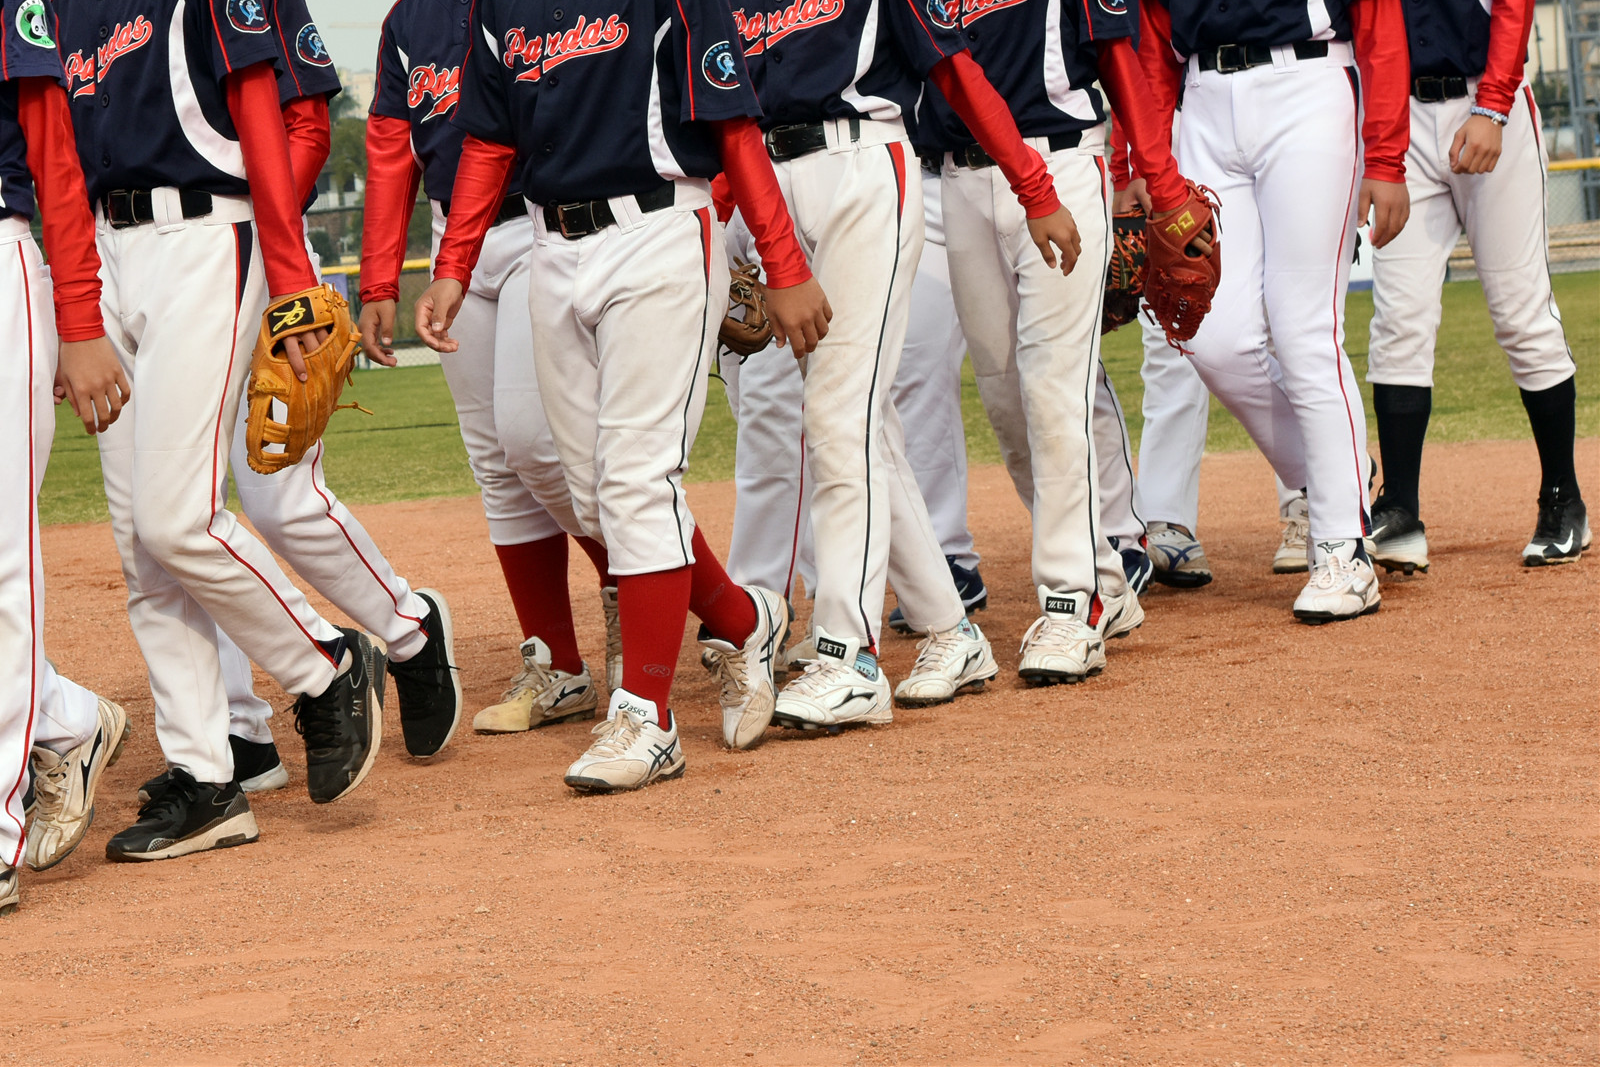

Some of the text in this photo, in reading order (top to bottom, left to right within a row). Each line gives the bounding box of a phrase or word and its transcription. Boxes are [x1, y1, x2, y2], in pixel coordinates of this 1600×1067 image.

[64, 14, 153, 99] Pandas
[503, 13, 630, 83] Pandas
[1047, 599, 1075, 611] ZETT
[818, 640, 846, 658] ZETT
[626, 704, 649, 718] asics
